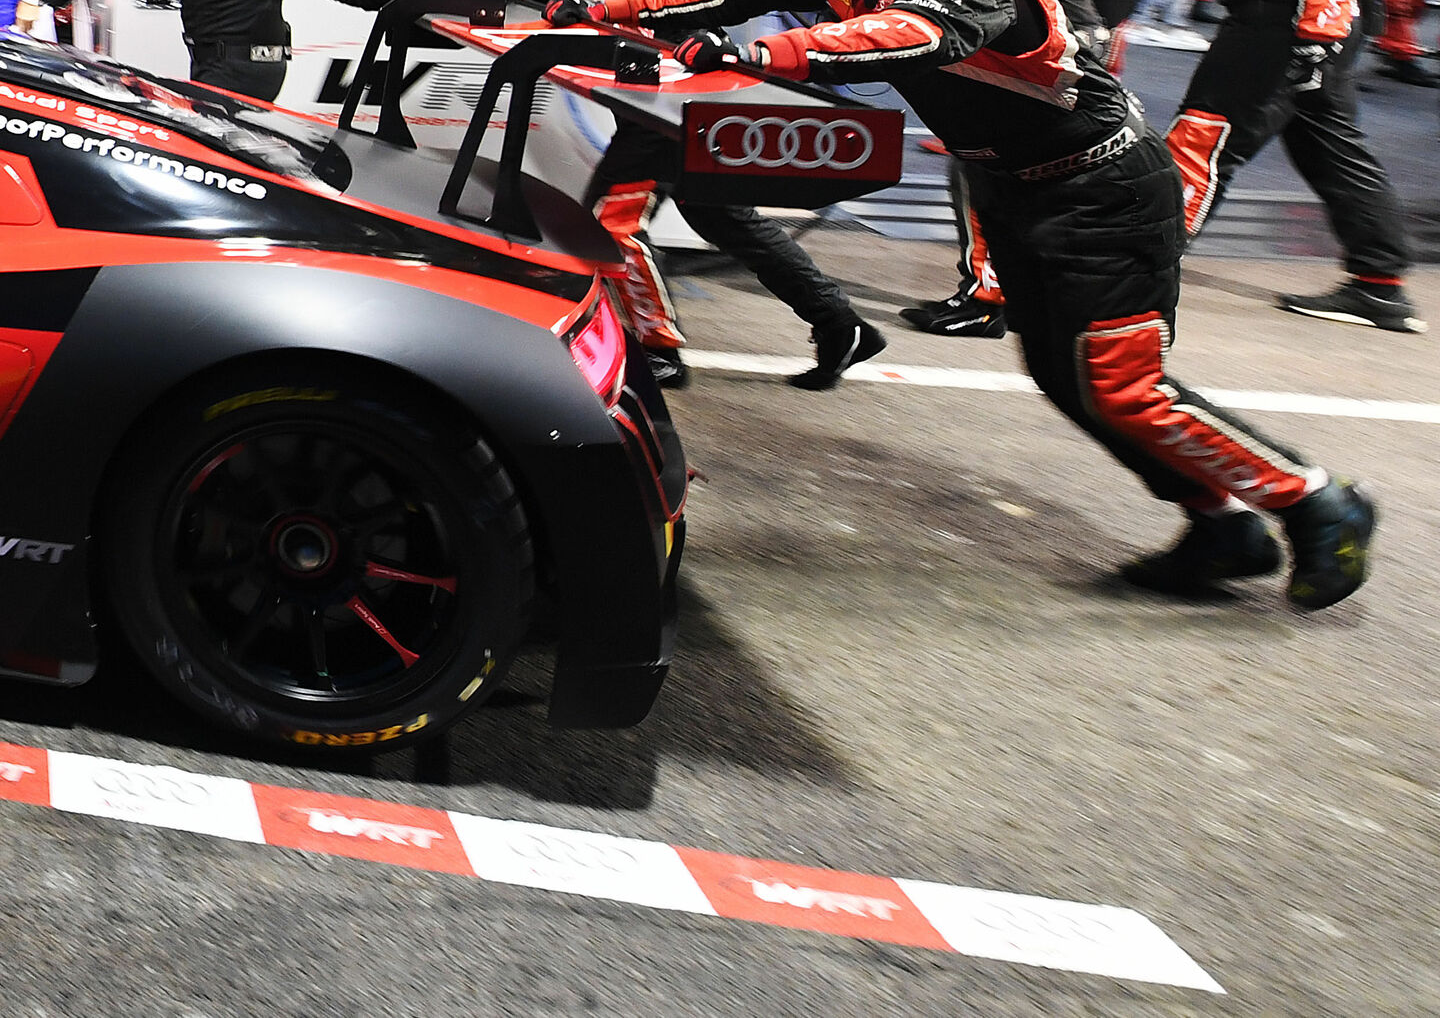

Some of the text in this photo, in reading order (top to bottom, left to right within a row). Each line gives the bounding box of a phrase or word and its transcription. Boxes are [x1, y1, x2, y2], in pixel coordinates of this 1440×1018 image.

[75, 105, 171, 142] Sport
[308, 810, 445, 849] WRT
[751, 879, 902, 921] WRT
